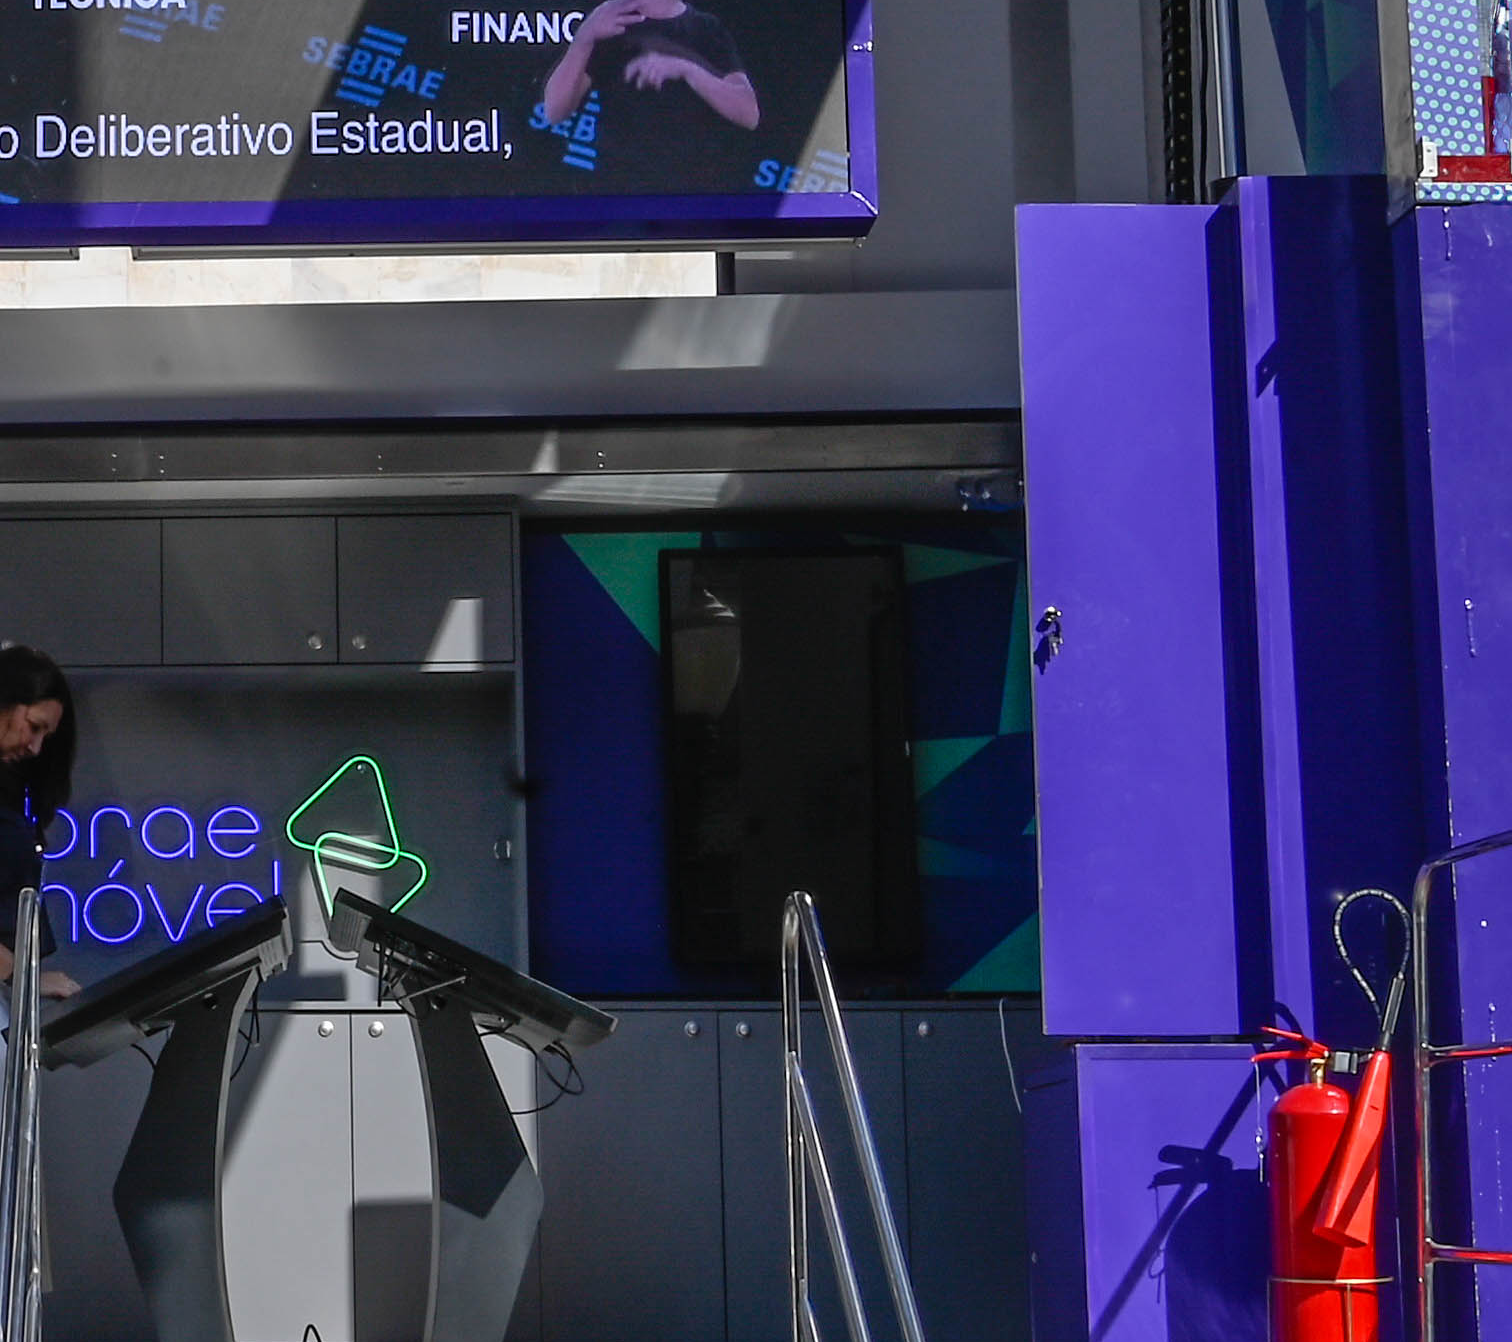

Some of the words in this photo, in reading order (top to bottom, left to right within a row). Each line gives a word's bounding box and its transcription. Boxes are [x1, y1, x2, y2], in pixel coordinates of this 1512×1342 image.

[450, 11, 585, 46] FINANC
[301, 36, 446, 100] SEBRAE
[35, 112, 294, 160] Deliberativo
[310, 109, 514, 161] Estadual,
